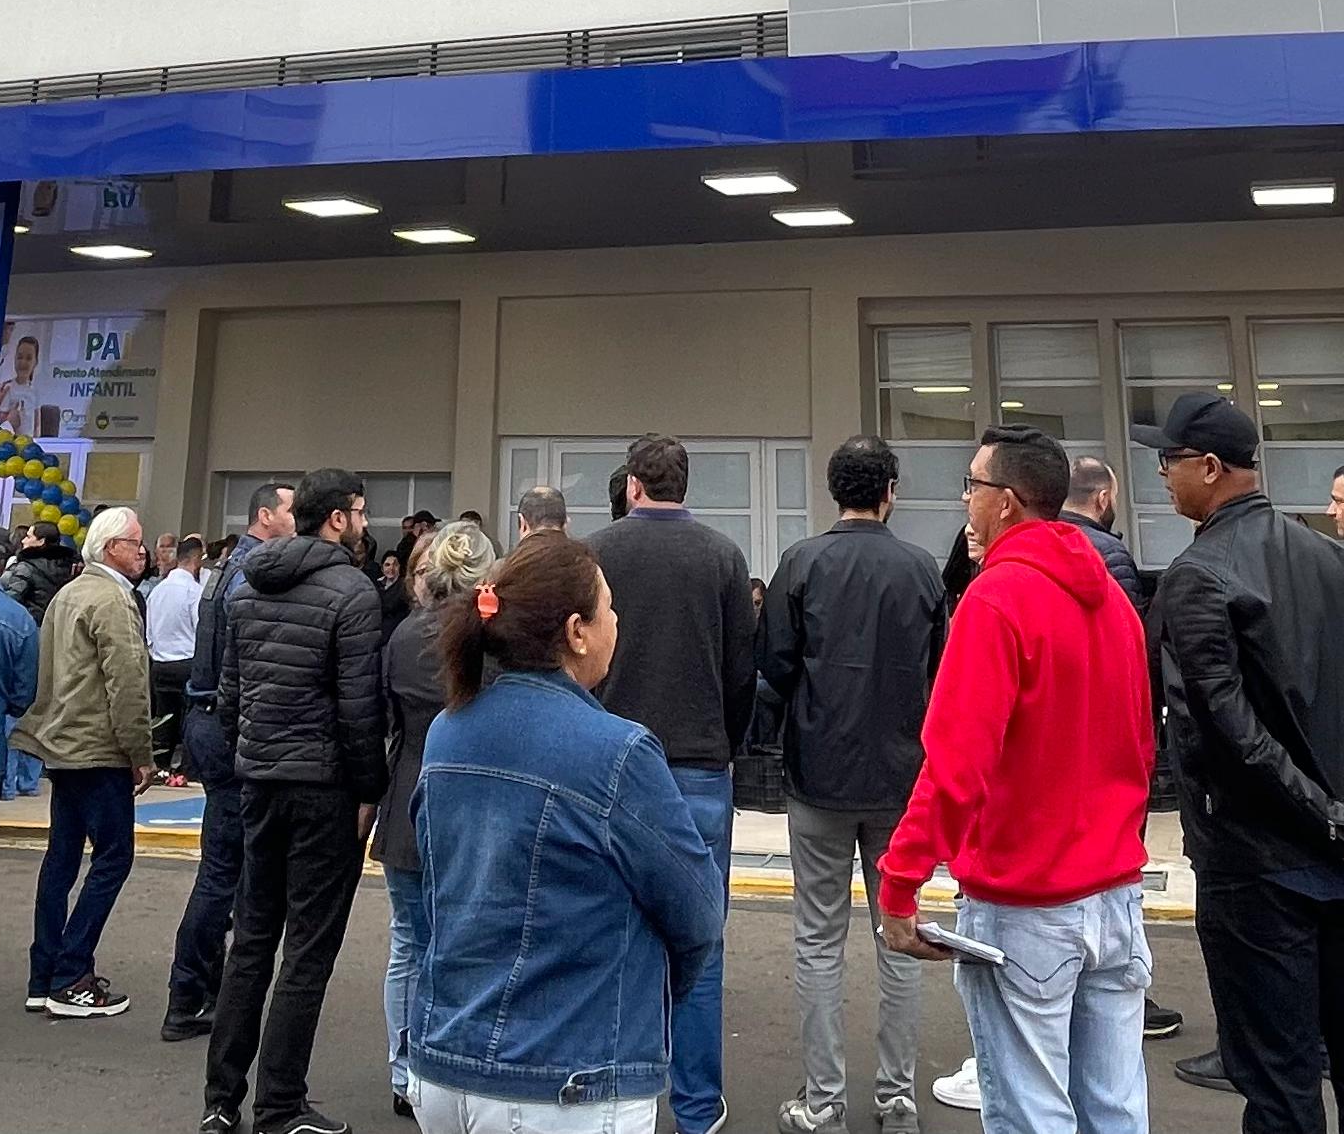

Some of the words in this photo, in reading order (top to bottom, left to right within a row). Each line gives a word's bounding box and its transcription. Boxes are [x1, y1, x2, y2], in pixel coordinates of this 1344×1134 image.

[53, 367, 87, 378] Pronto
[88, 366, 156, 378] Atendimento
[69, 382, 136, 397] INFANTIL
